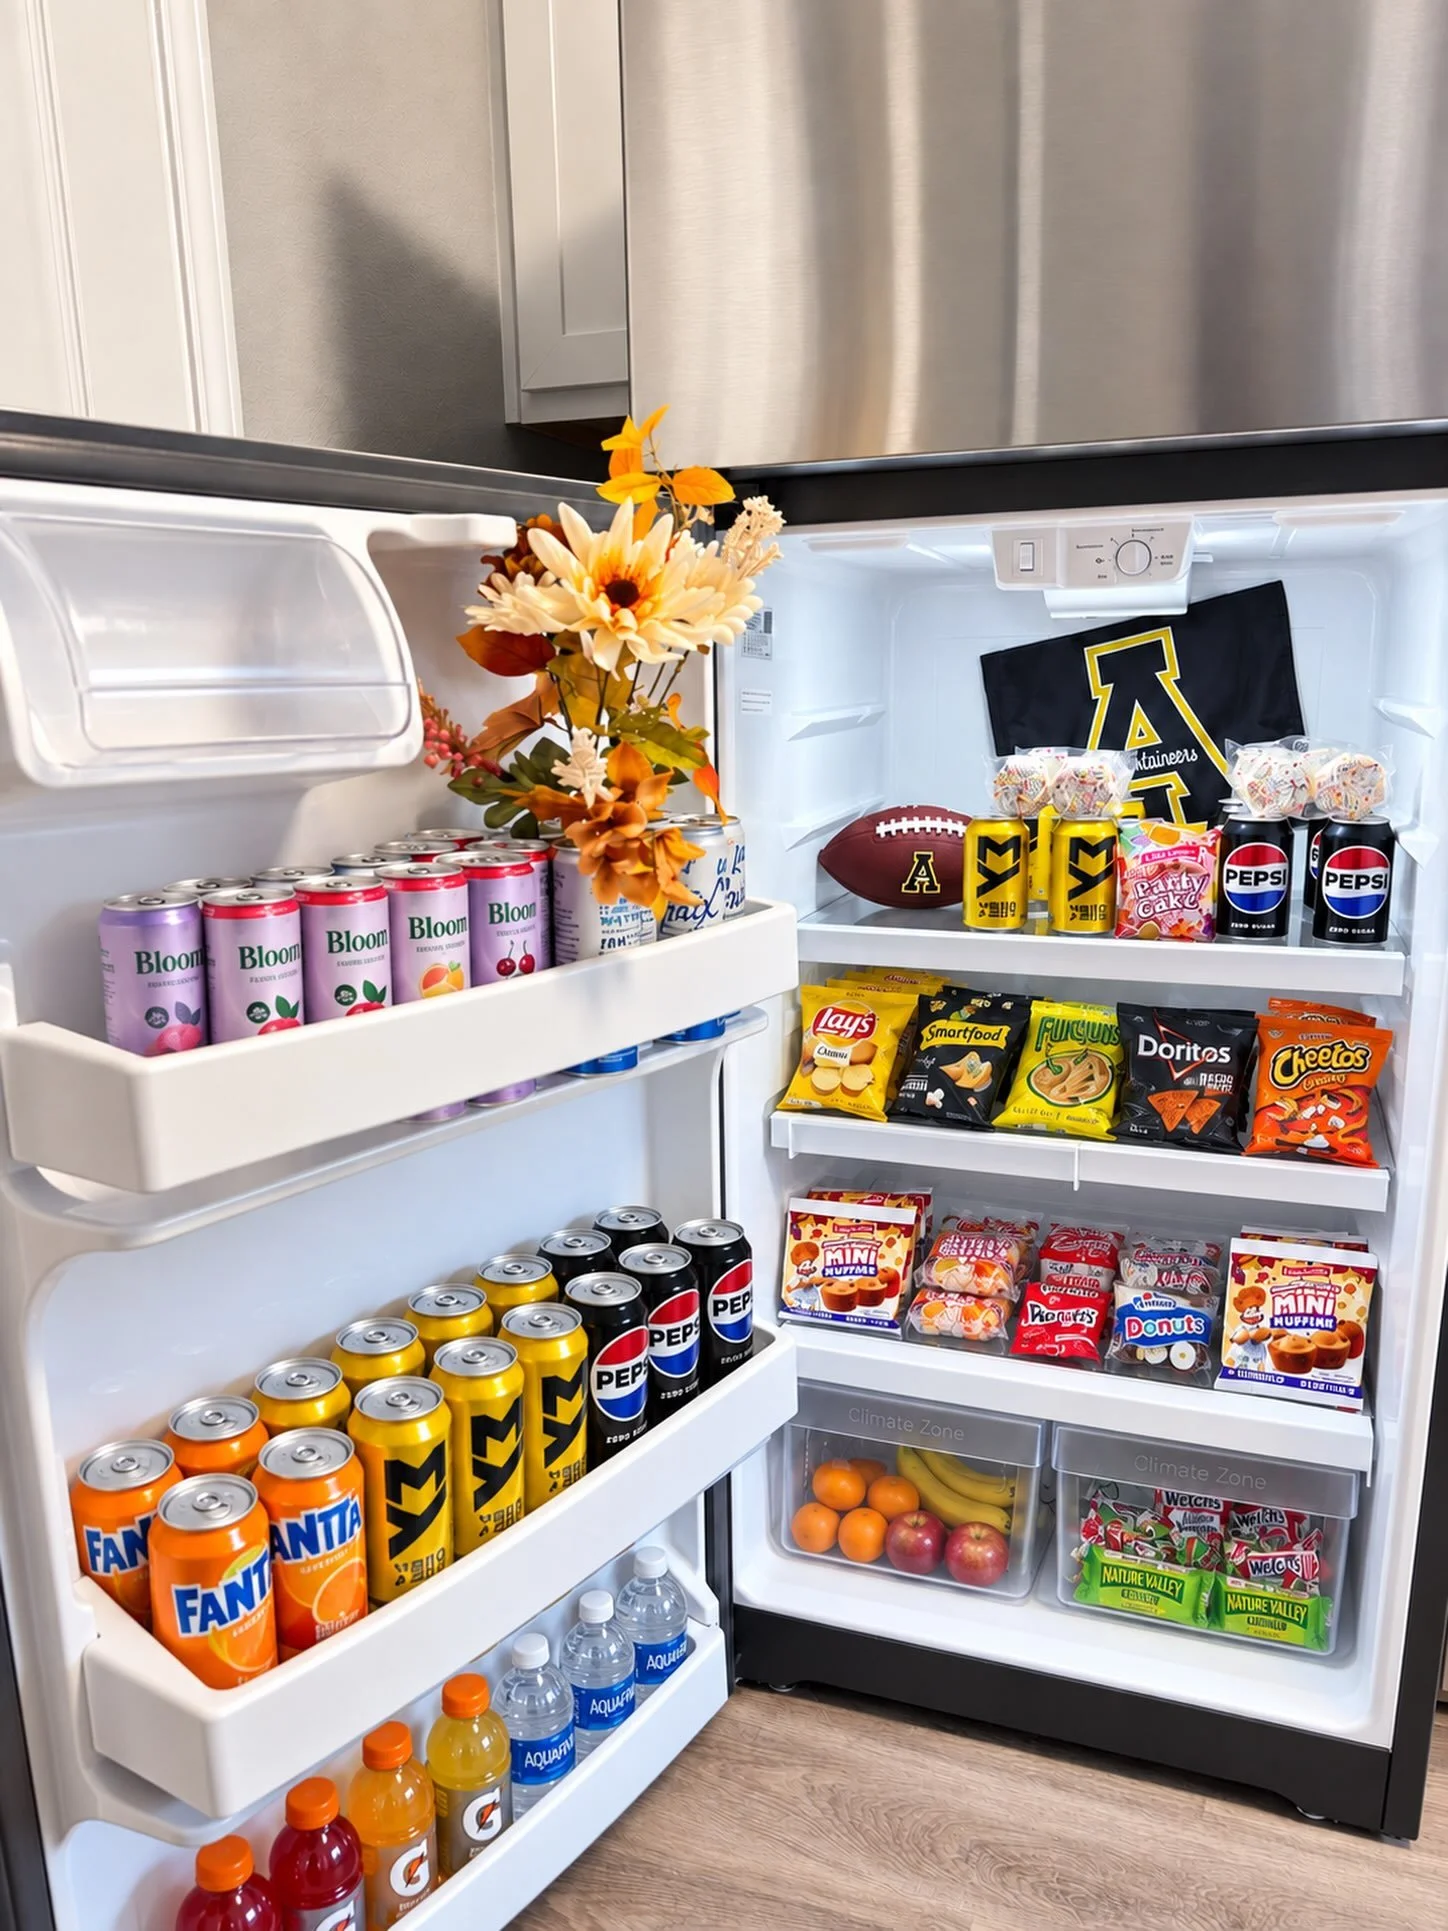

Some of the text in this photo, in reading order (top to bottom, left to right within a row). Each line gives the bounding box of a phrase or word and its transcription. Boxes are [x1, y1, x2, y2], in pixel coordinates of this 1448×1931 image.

[1136, 748, 1199, 771] taineers
[901, 851, 940, 894] A
[1225, 869, 1286, 886] PEPSI
[1325, 871, 1387, 890] PEPSI
[326, 928, 389, 955] Bloom
[408, 915, 468, 940] Bloom
[134, 949, 204, 975] Bloom
[238, 943, 301, 970] Bloom
[816, 1008, 877, 1039] Lay's
[926, 1024, 1003, 1044] Smartfood
[1137, 1034, 1232, 1065] Doritos
[1272, 1043, 1368, 1086] Cheetos
[713, 1291, 751, 1317] PEP
[1126, 1316, 1205, 1339] Donuts
[849, 1407, 965, 1441] Climate Zone
[1134, 1455, 1267, 1490] Climate Zone
[85, 1512, 148, 1573] FAN
[172, 1545, 271, 1637] FANT
[1226, 1593, 1268, 1614] NATURE
[1269, 1602, 1308, 1627] VALLEY
[463, 1787, 503, 1841] G
[390, 1838, 430, 1897] G
